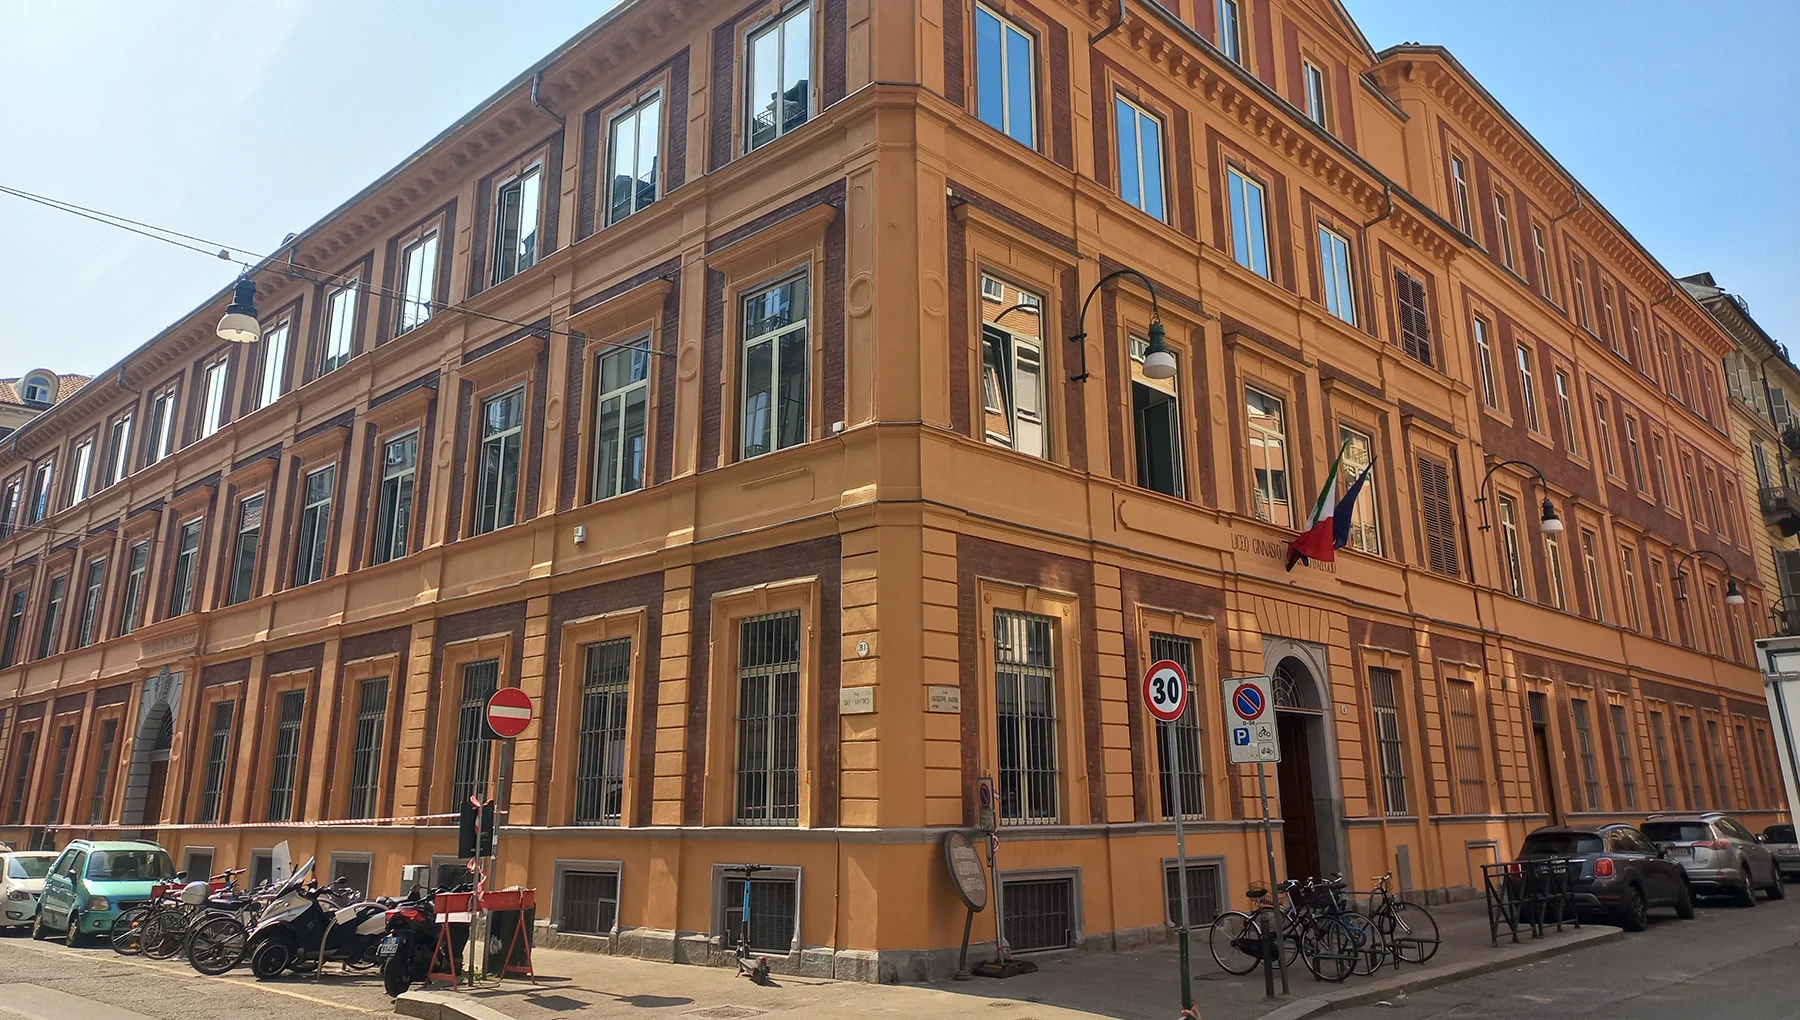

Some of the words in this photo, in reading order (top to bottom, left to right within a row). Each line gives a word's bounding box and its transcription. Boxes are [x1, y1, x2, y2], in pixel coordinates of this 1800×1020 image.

[1230, 532, 1250, 552] LICEO
[1152, 676, 1179, 704] 30
[1237, 729, 1248, 745] P
